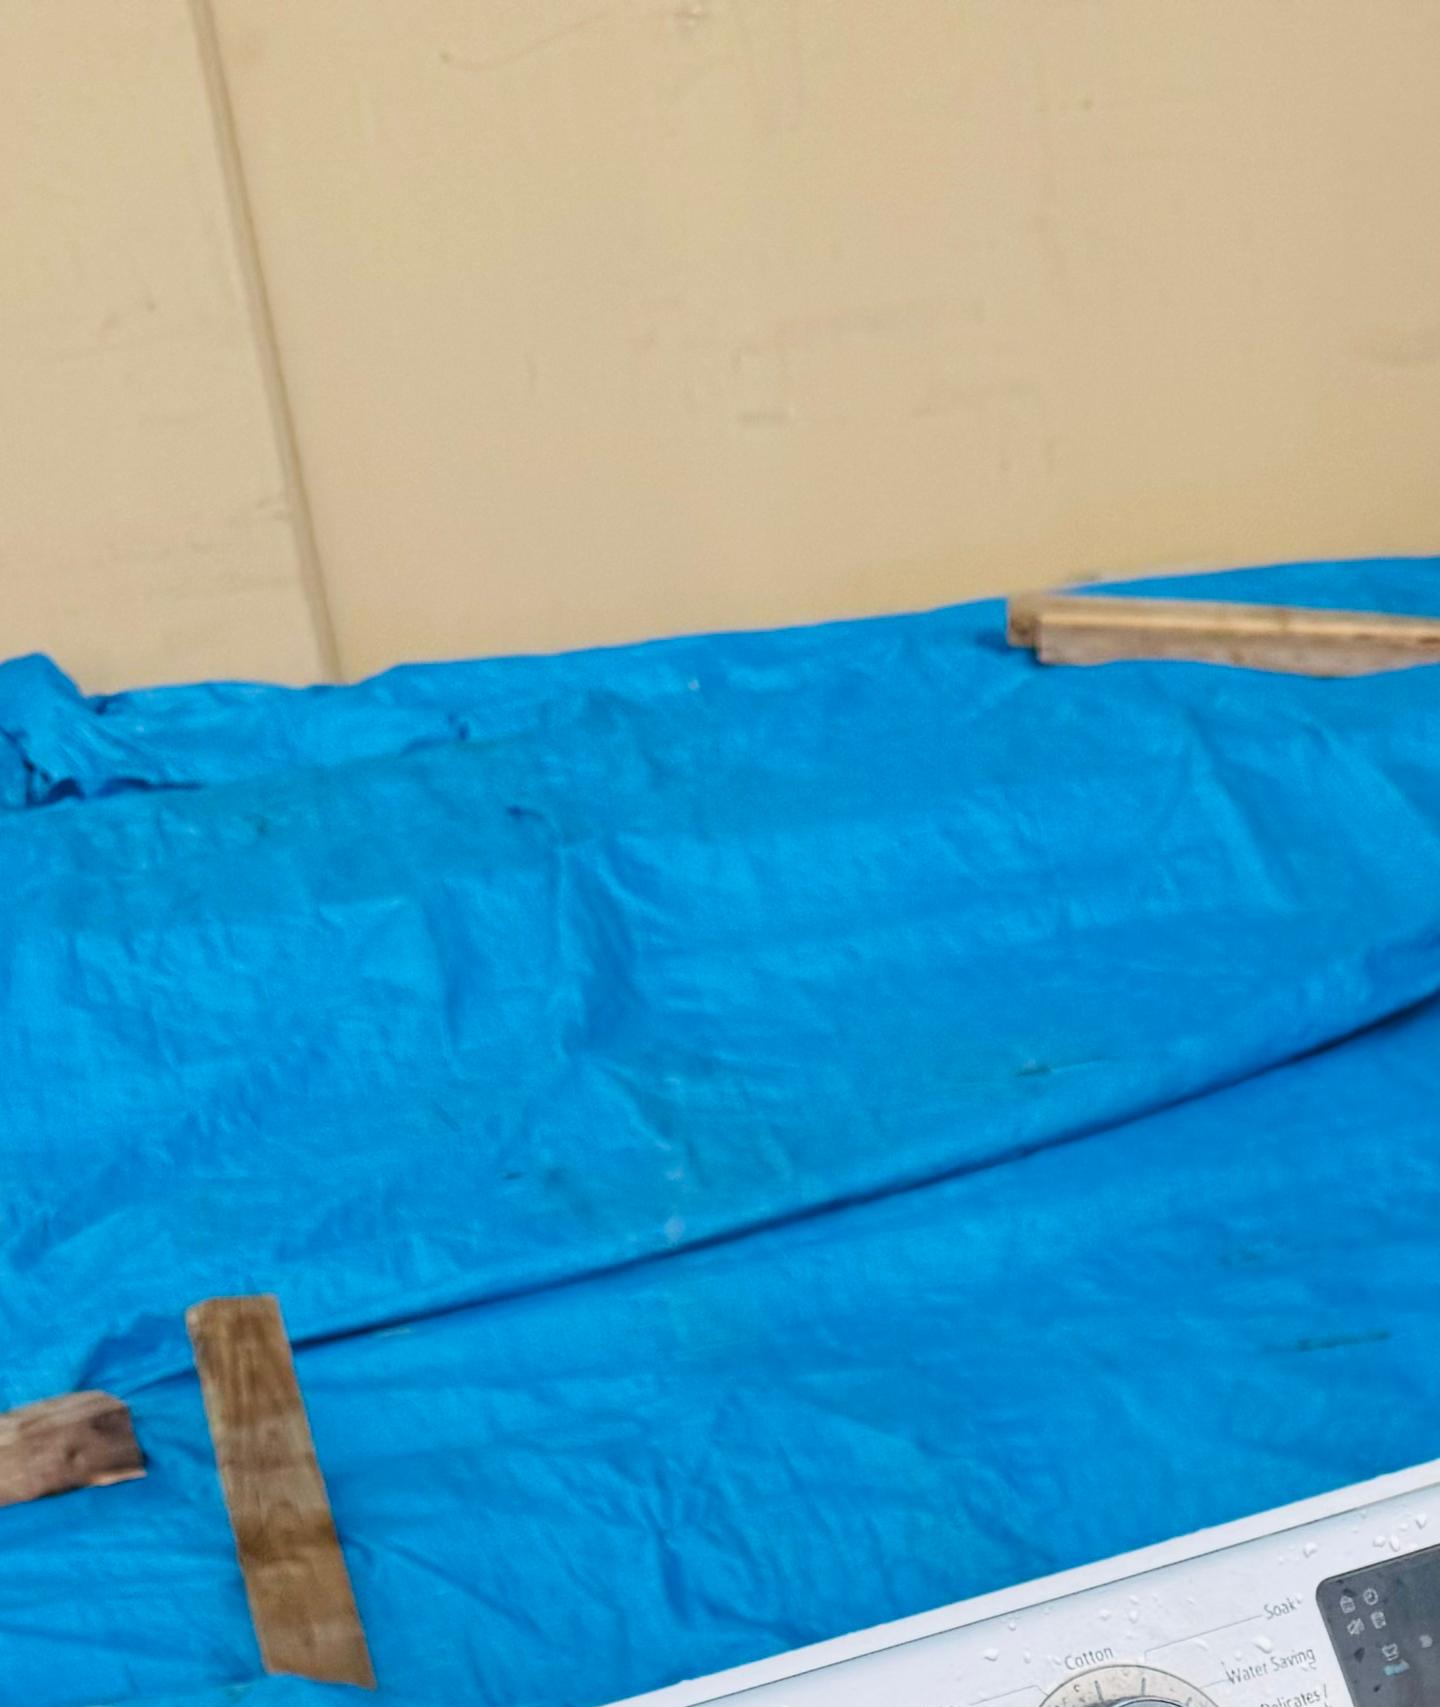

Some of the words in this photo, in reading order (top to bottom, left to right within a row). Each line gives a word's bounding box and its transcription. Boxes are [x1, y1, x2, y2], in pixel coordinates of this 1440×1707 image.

[1264, 1598, 1296, 1620] Soak
[1064, 1647, 1114, 1671] Cotton
[1225, 1663, 1268, 1684] Water
[1270, 1648, 1317, 1672] Saving
